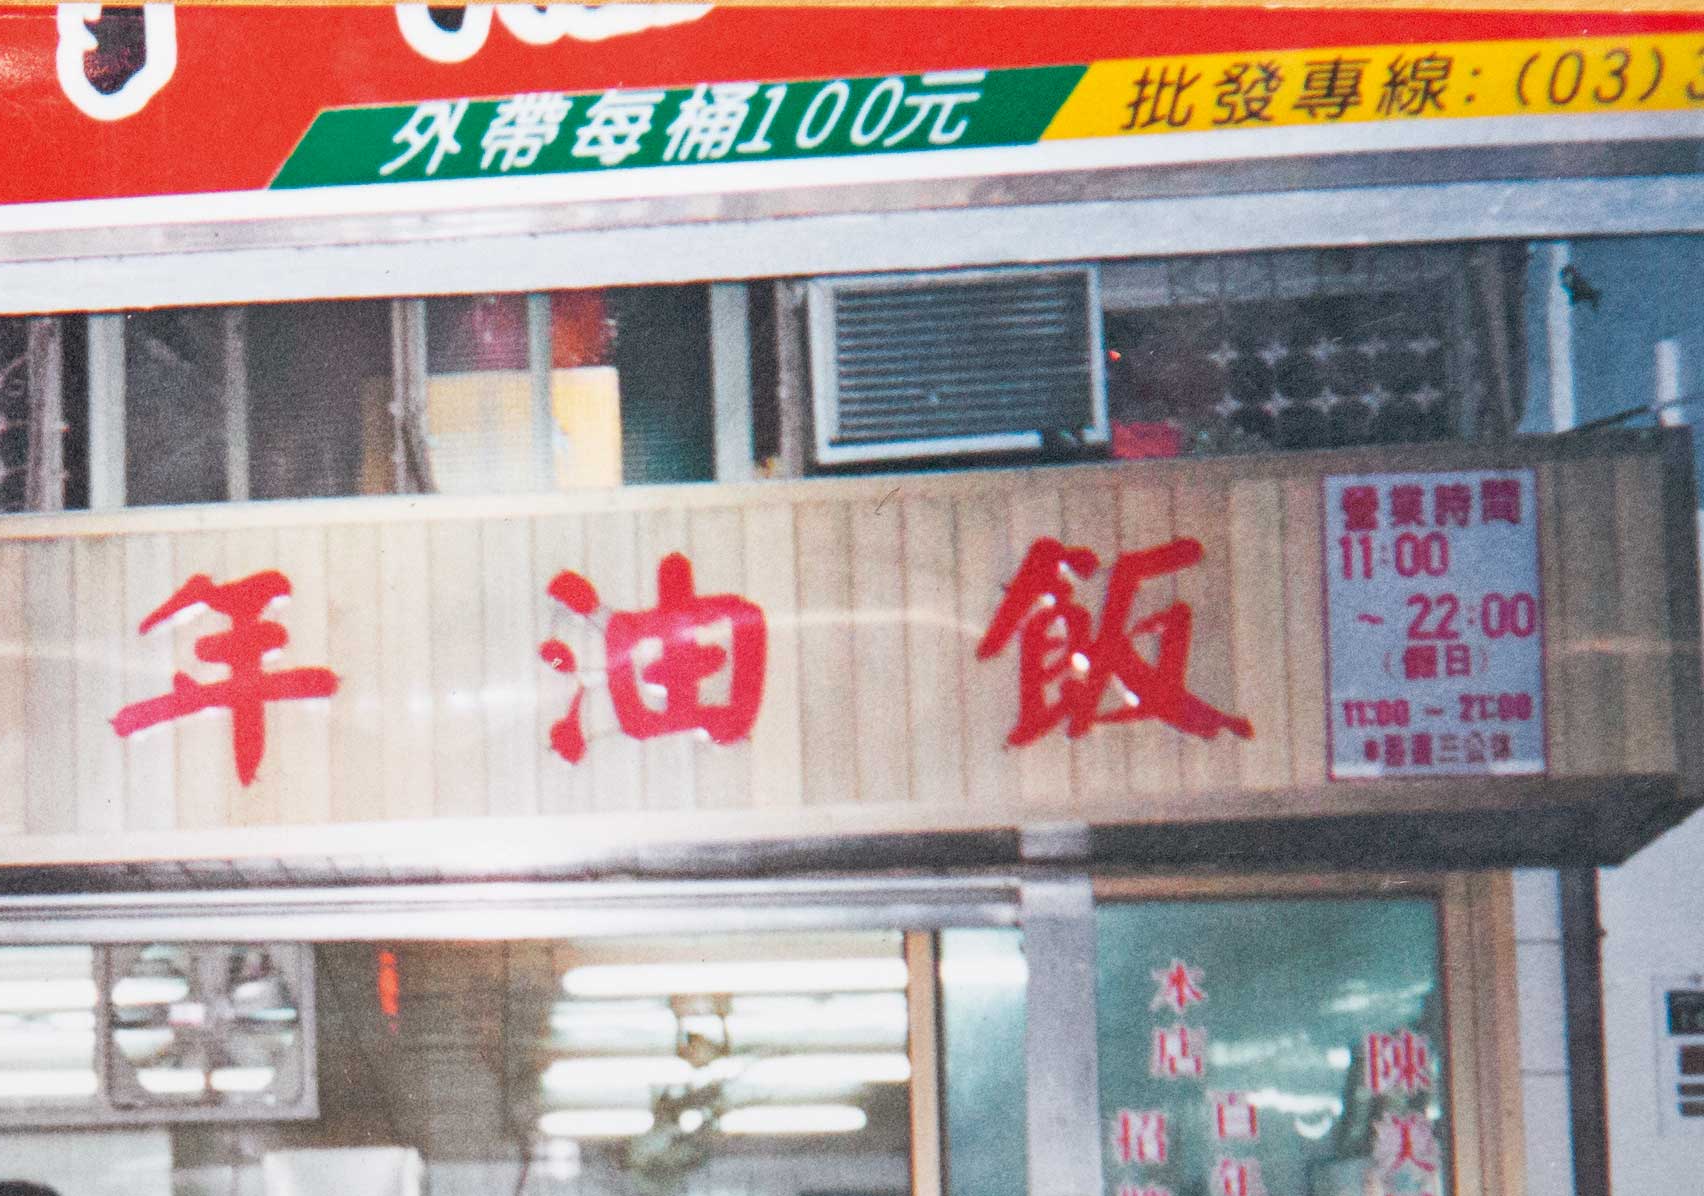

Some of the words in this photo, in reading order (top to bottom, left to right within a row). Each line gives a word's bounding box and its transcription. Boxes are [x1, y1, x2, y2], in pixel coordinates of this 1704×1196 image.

[1119, 47, 1704, 131] 批發專線:(03)
[379, 68, 988, 178] 外帶每桶100元
[1341, 478, 1522, 532] 營業時間
[1339, 531, 1449, 581] 11:00
[1405, 591, 1538, 641] 22:00
